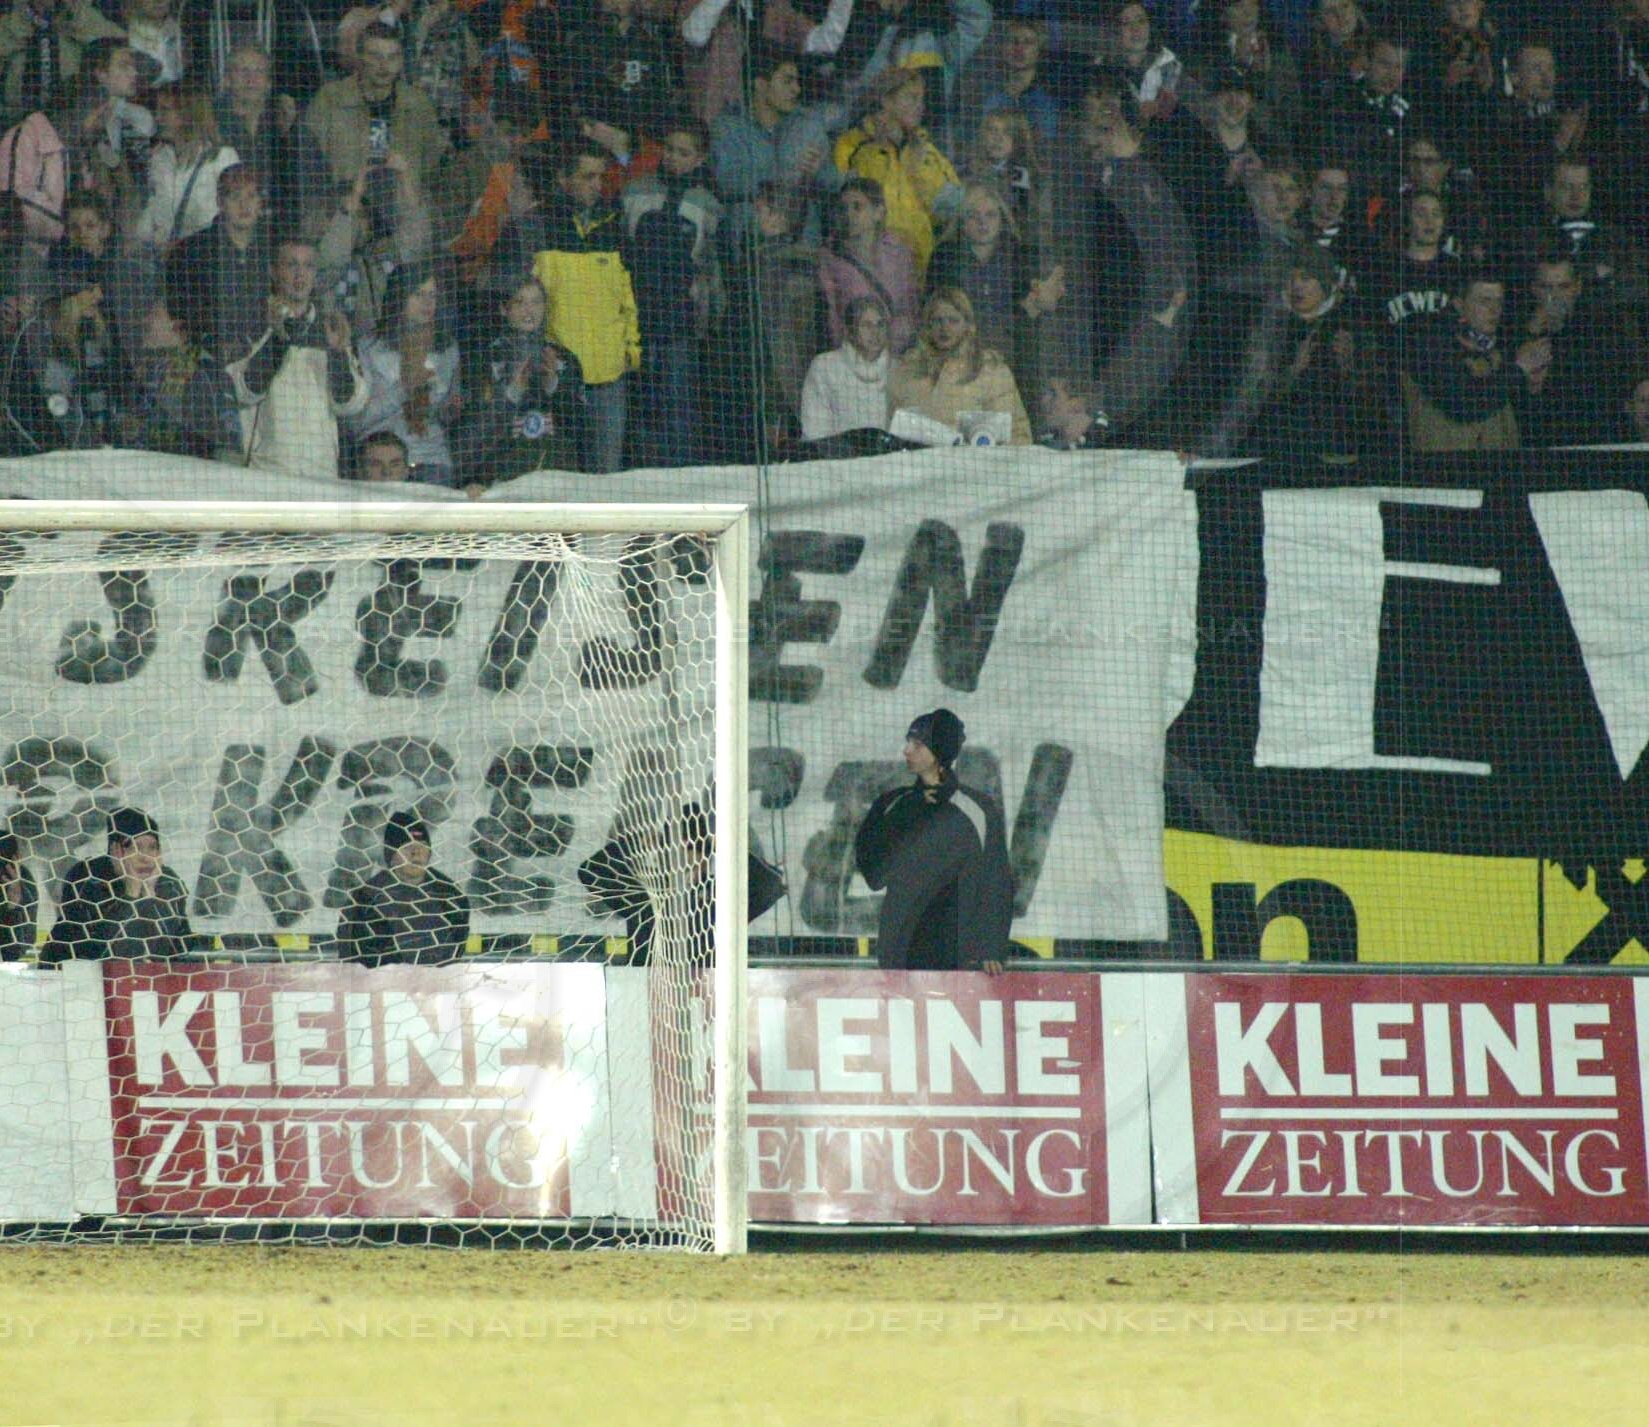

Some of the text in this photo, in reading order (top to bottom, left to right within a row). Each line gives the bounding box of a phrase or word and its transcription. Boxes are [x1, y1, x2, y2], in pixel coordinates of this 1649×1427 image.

[132, 990, 536, 1087] KLEINE
[1213, 1002, 1616, 1097] KLEINE
[139, 1119, 549, 1190] ZEITUNG
[1220, 1129, 1628, 1197] ZEITUNG
